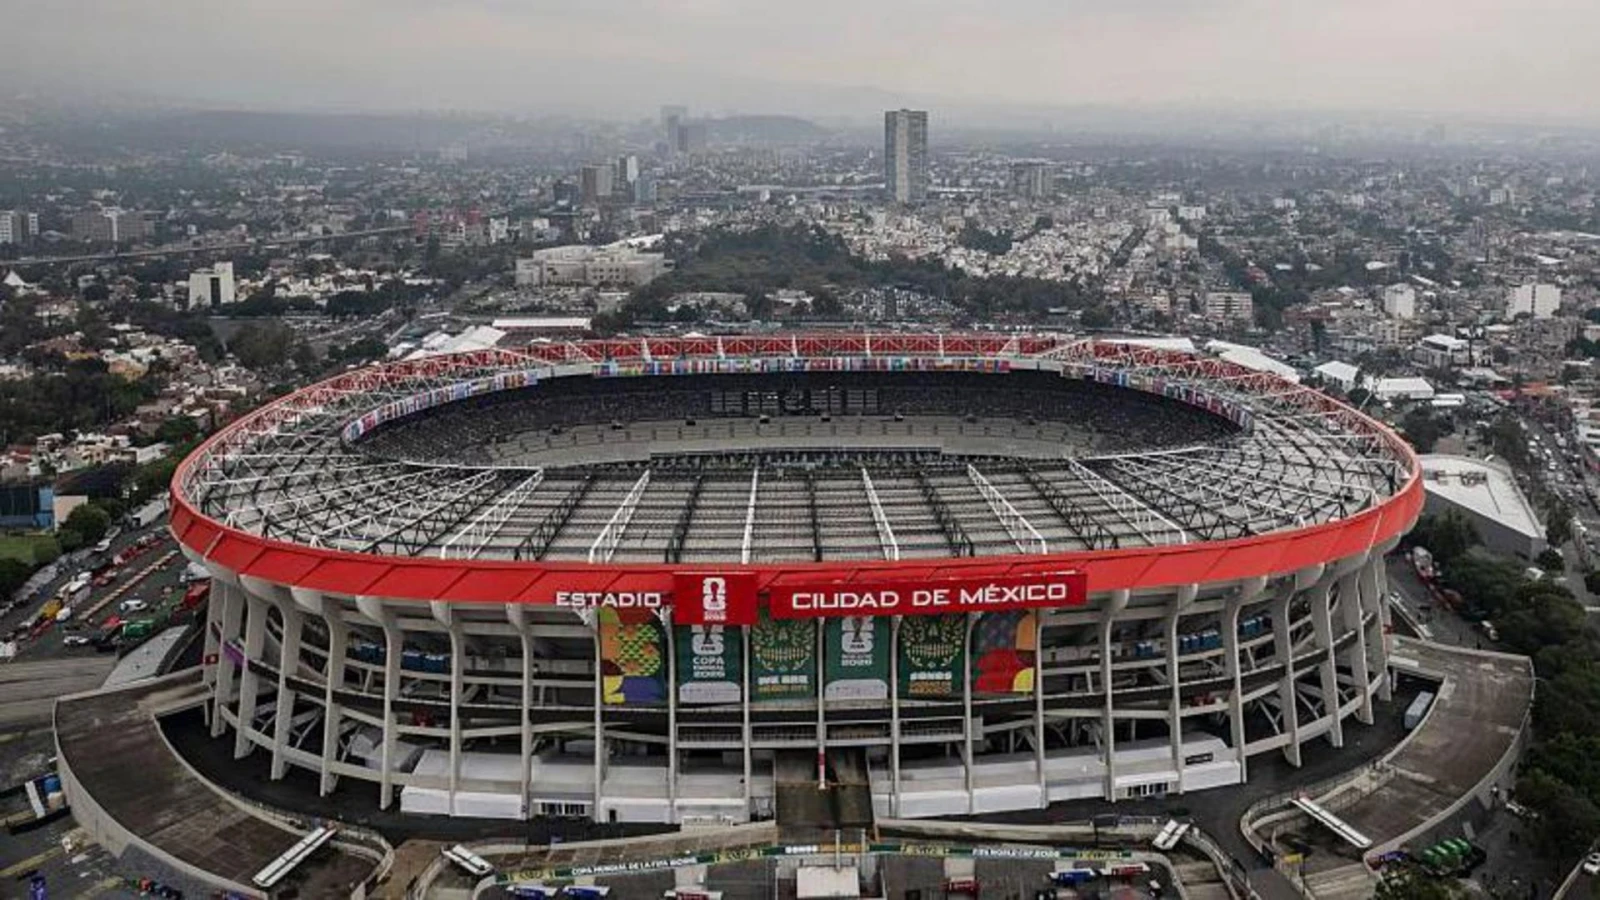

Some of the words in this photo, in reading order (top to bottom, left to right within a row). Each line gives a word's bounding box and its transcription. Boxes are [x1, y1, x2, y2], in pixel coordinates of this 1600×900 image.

[555, 591, 662, 608] ESTADIO
[792, 590, 900, 610] CIUDAD
[912, 588, 951, 606] DE
[959, 582, 1067, 605] MÉXICO
[693, 656, 724, 665] COPA
